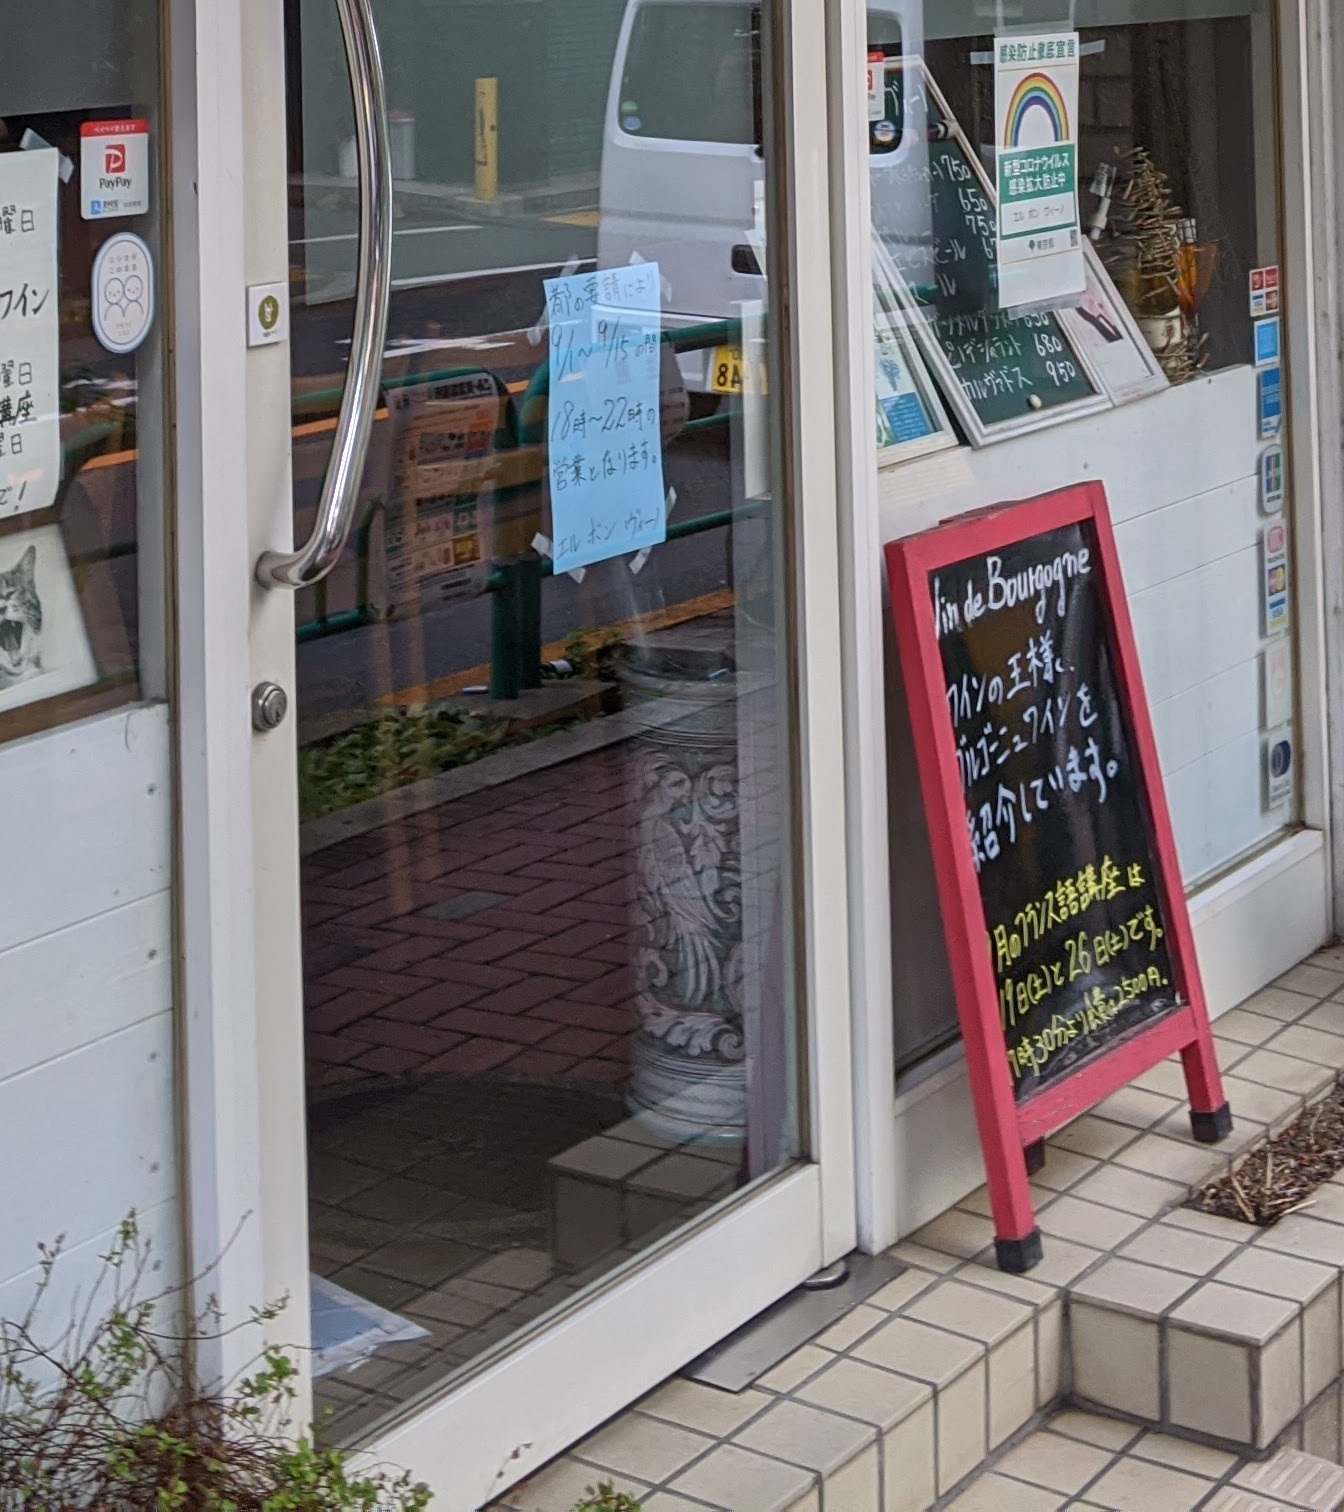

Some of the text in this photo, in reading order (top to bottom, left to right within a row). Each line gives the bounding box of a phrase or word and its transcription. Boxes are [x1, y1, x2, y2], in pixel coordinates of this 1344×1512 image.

[940, 154, 972, 182] 750
[99, 177, 133, 190] PayPay
[958, 188, 988, 213] 650
[1033, 333, 1062, 357] 680
[1045, 360, 1076, 387] 950
[986, 548, 1092, 625] Bourgogne
